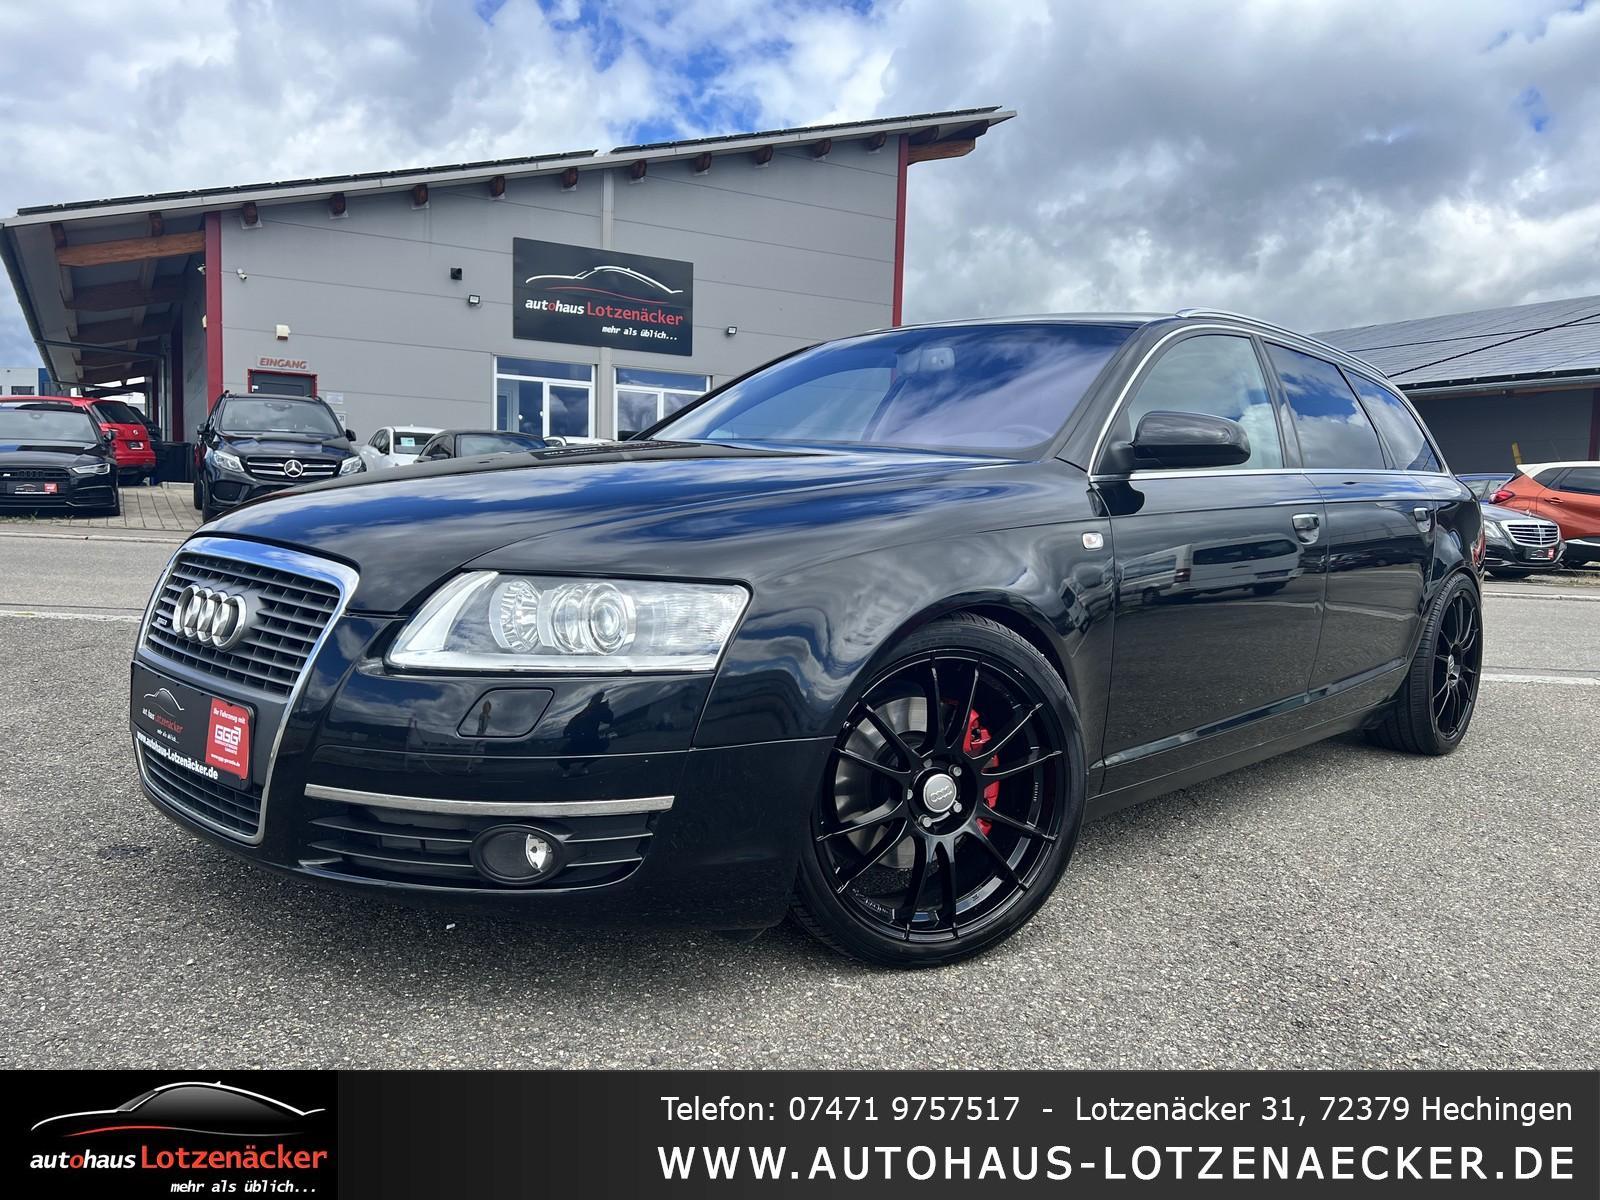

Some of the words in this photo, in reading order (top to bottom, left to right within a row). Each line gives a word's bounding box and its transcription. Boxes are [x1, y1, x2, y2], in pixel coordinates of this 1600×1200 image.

[525, 299, 585, 315] autohaus
[587, 302, 684, 326] Lotzenäcker
[601, 325, 621, 335] mehr
[623, 328, 638, 337] als
[640, 329, 678, 341] üblich...
[260, 358, 307, 369] EINGANG
